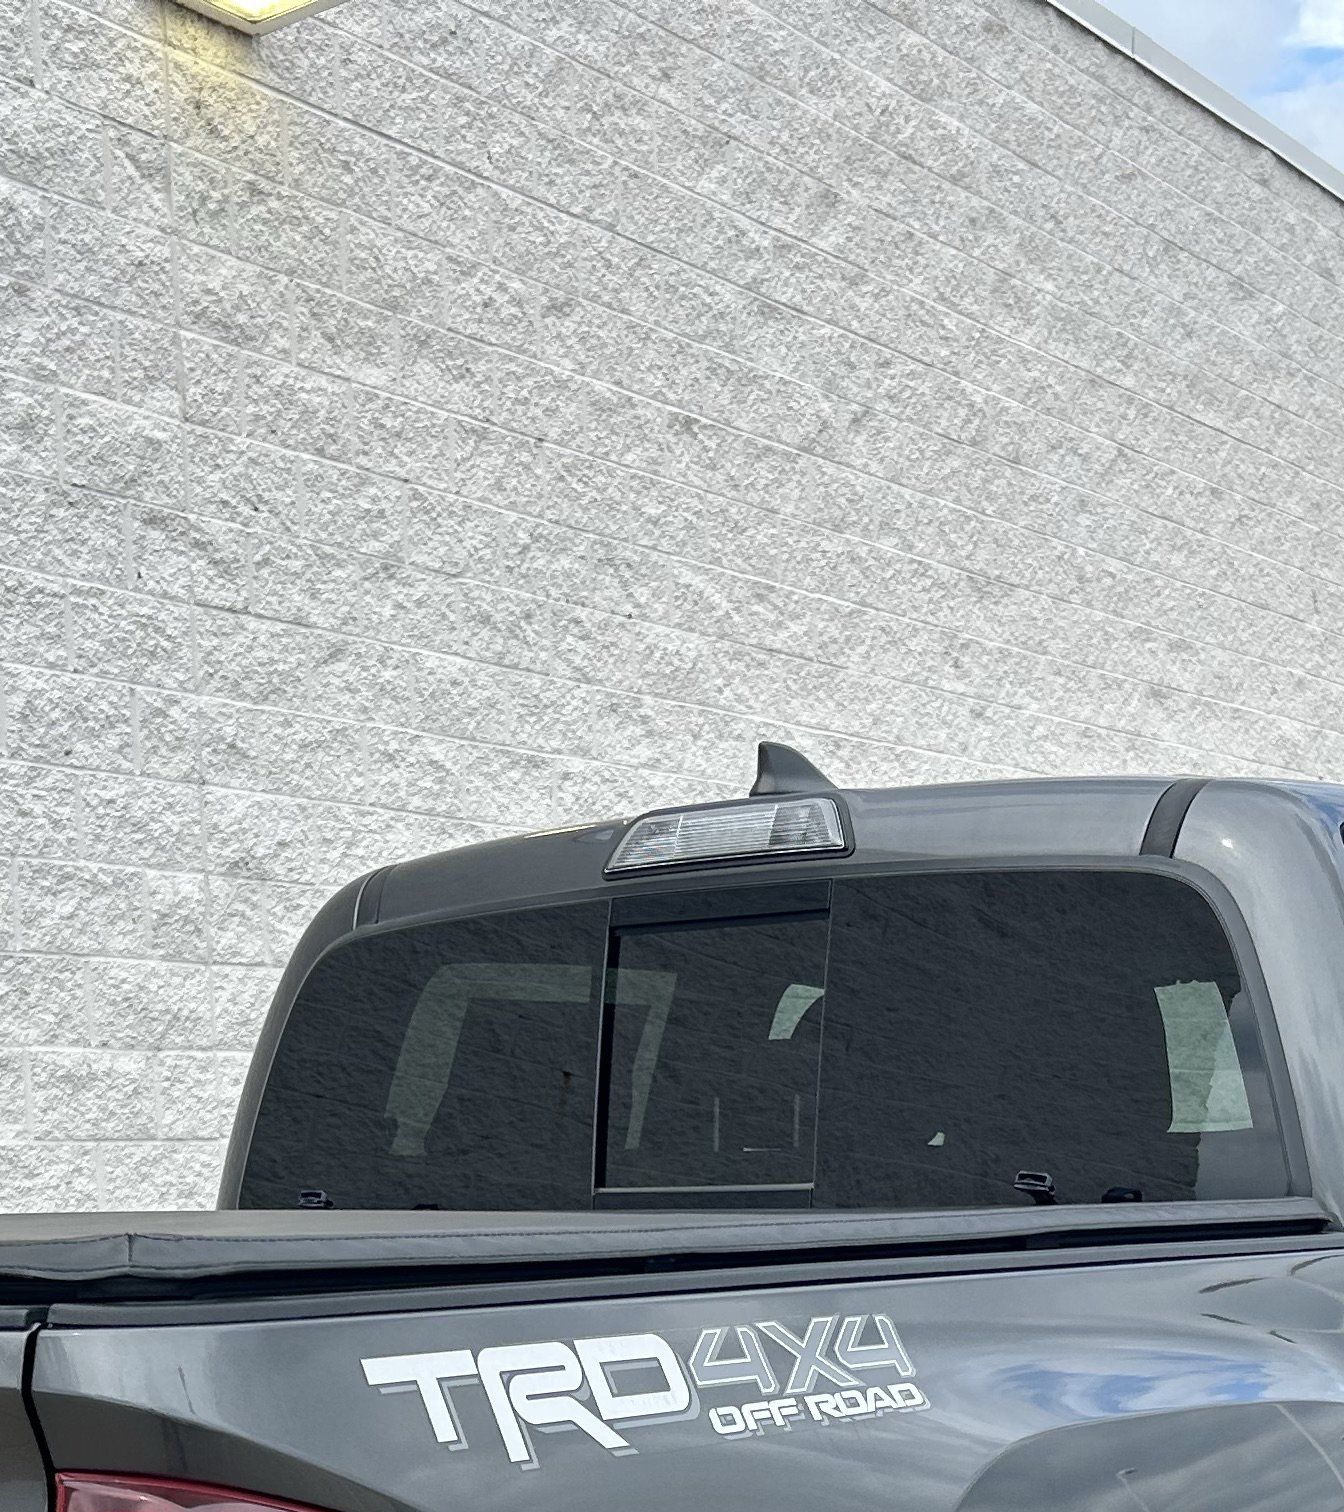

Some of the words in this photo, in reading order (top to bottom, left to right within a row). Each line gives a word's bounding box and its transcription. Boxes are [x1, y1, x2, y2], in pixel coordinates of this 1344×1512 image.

[360, 1334, 692, 1464] TRD
[689, 1314, 915, 1395] 4X4
[709, 1398, 800, 1435] OFF
[804, 1382, 926, 1423] ROAD
